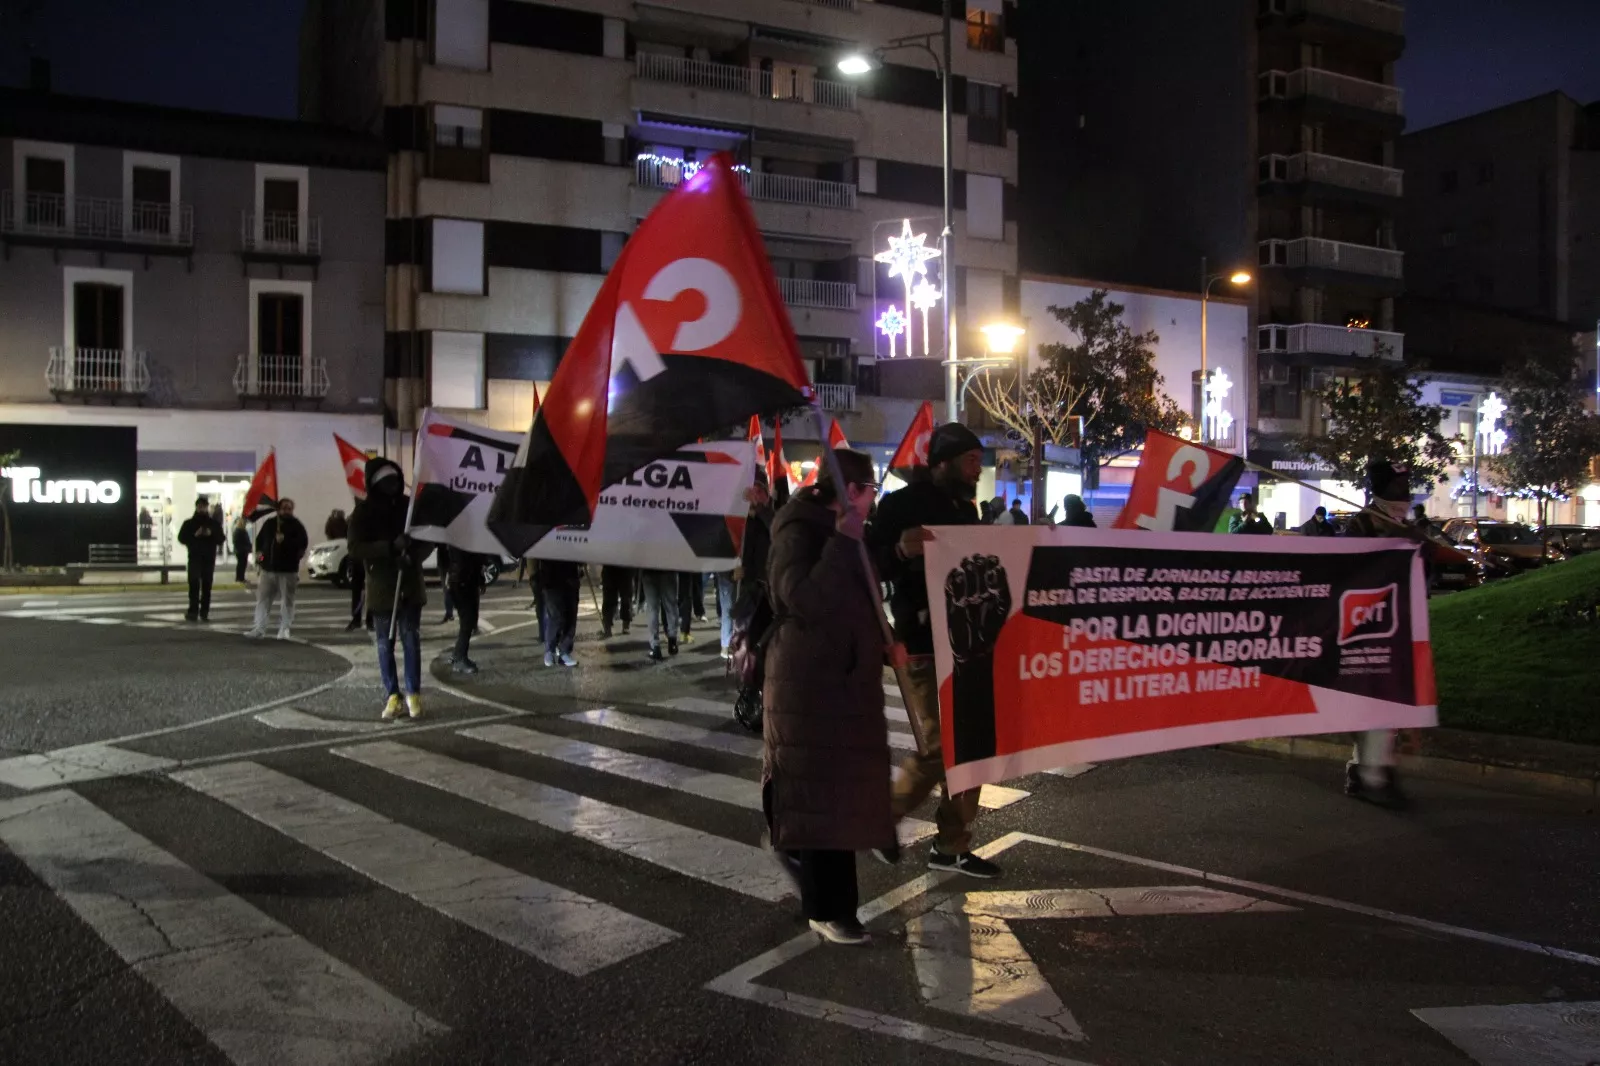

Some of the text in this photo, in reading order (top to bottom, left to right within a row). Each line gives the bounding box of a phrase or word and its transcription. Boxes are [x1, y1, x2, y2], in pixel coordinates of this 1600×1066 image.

[459, 445, 486, 471] A
[0, 466, 121, 504] Turmo
[599, 495, 617, 506] us
[622, 494, 700, 511] derechos!
[1069, 567, 1120, 587] ¡BASTA
[1123, 568, 1147, 582] DE
[1147, 569, 1231, 583] JORNADAS
[1027, 584, 1332, 606] BASTA DE DESPIDOS, BASTA DE ACCIDENTES!
[1351, 601, 1387, 626] CNT
[1063, 610, 1283, 650] ¡POR LA DIGNIDAD y
[1019, 636, 1323, 680] LOS DERECHOS LABORALES
[1079, 666, 1261, 705] EN LITERA MEAT!
